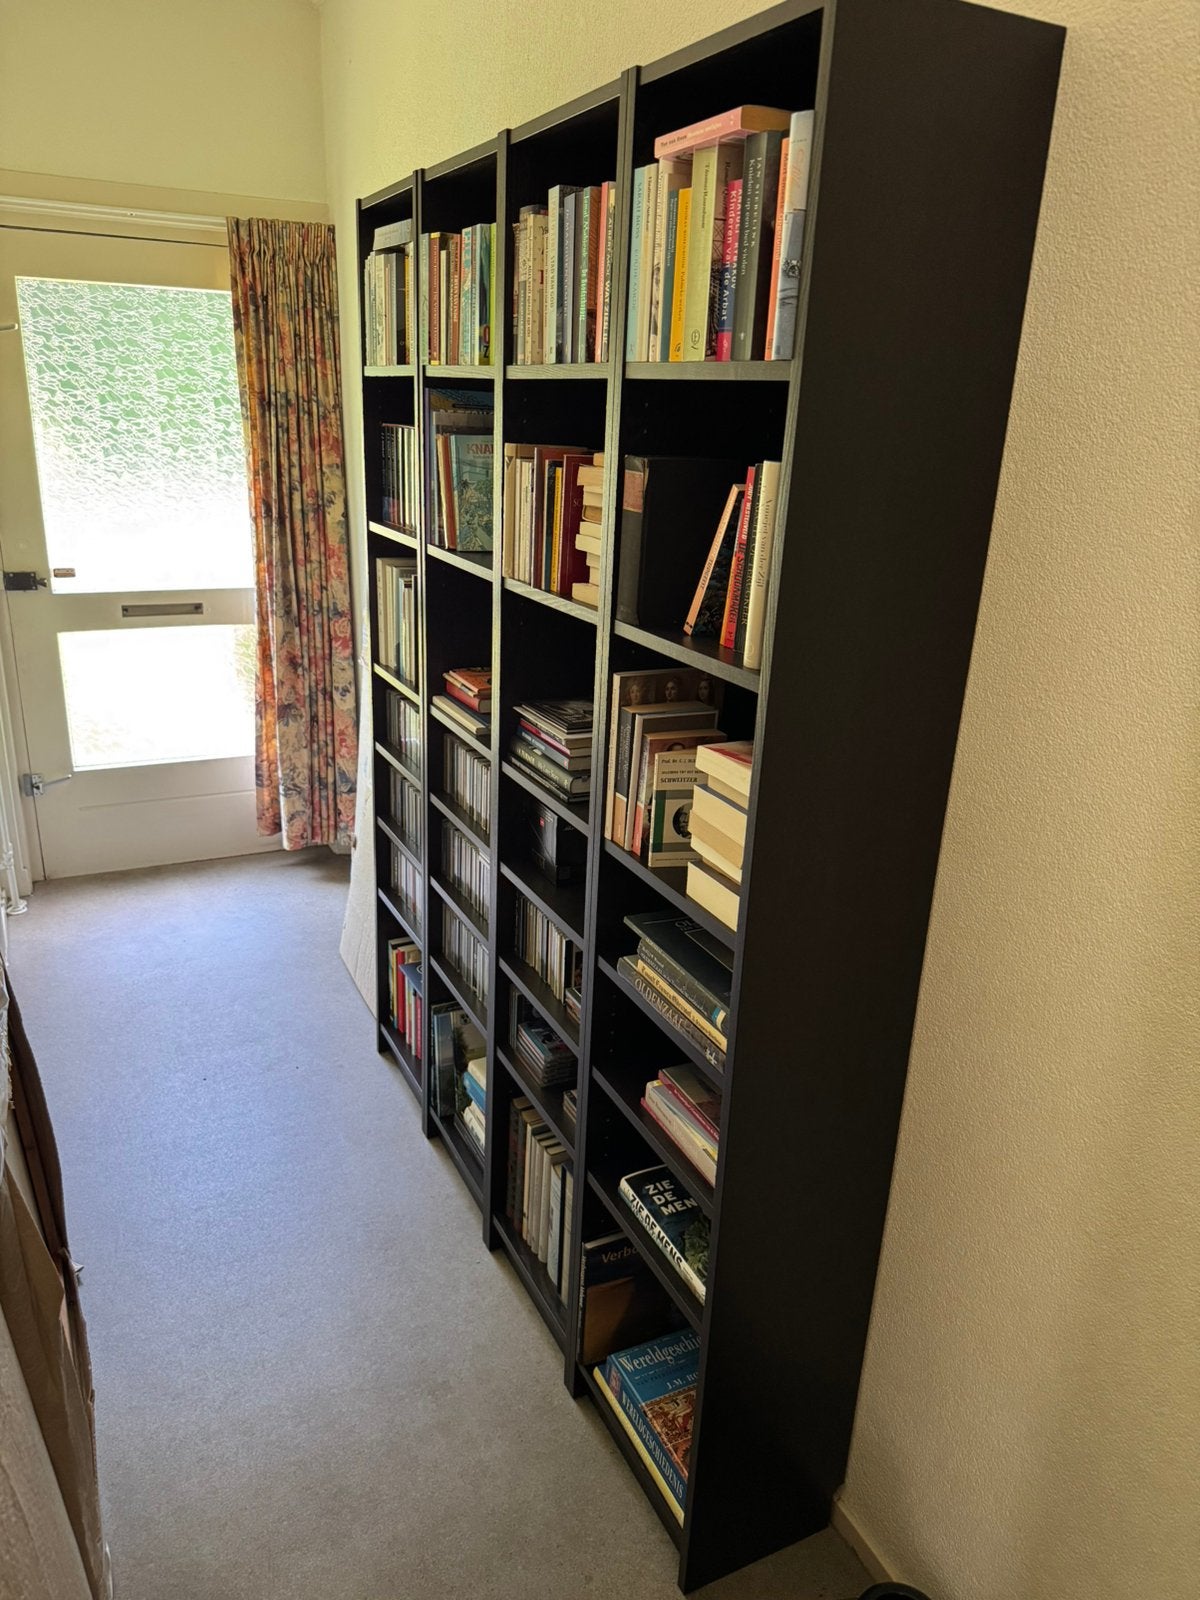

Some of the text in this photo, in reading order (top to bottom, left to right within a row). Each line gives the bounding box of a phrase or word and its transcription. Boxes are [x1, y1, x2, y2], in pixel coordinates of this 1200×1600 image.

[745, 158, 756, 195] Knielen
[749, 156, 762, 248] JAN SIEBELINK
[725, 189, 737, 247] Kinderen
[743, 211, 751, 228] een
[742, 229, 750, 247] bed
[724, 247, 733, 268] van
[740, 247, 749, 275] violen
[723, 271, 731, 285] de
[720, 288, 730, 321] Arbat
[467, 443, 494, 454] KNA
[760, 498, 773, 534] Annejet
[754, 570, 765, 588] Zijl
[634, 977, 685, 1031] OLDENZAAL
[644, 1178, 675, 1195] ZIE
[653, 1191, 678, 1205] DE
[630, 1193, 685, 1269] ZIE DE MENS
[665, 1378, 687, 1391] J.M.
[621, 1389, 686, 1499] WERELDGESCHIEDENIS
